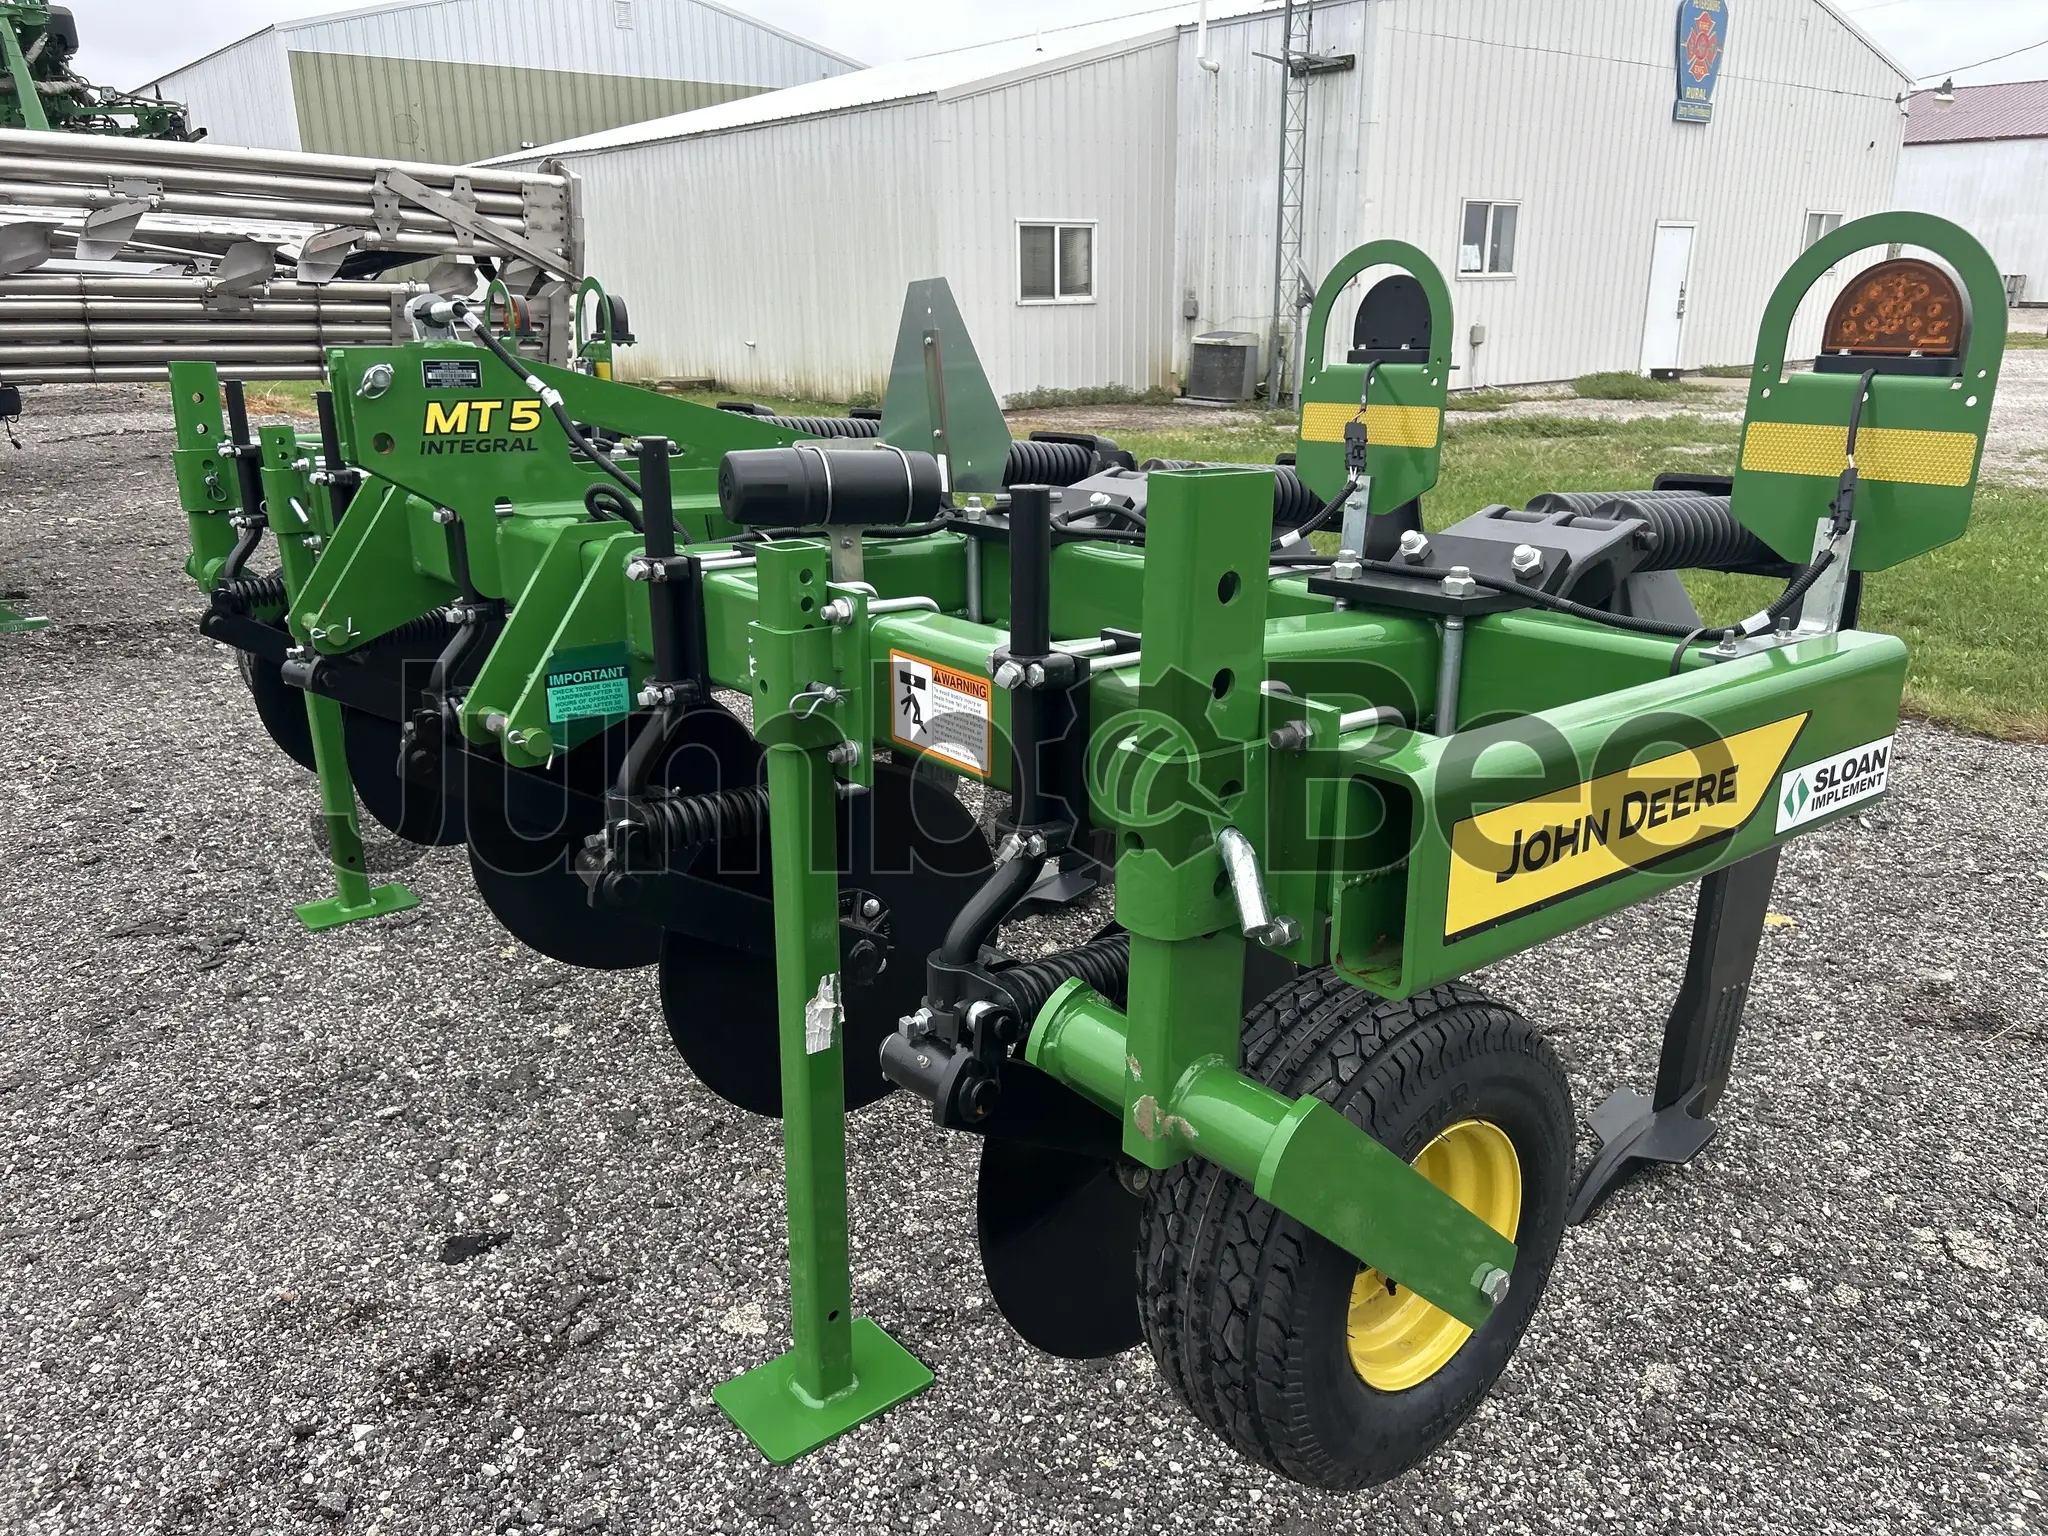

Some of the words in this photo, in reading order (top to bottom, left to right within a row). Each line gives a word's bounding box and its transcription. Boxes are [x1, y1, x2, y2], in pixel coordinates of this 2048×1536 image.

[1686, 86, 1707, 101] RURAL
[423, 399, 504, 436] MT
[508, 398, 543, 434] 5
[420, 437, 539, 456] INTEGRAL
[549, 666, 625, 686] IMPORTANT
[552, 688, 574, 696] CHECK
[576, 684, 600, 692] TORQUE
[557, 691, 593, 701] HARDWARE
[941, 674, 987, 699] WARNING
[555, 700, 577, 708] HOURS
[588, 693, 624, 703] OPERATION
[590, 705, 624, 715] OPERATION
[1813, 745, 1889, 793] SLOAN
[1810, 771, 1885, 812] IMPLEMENT
[1496, 809, 1610, 883] JOHN
[1619, 765, 1739, 839] DEERE
